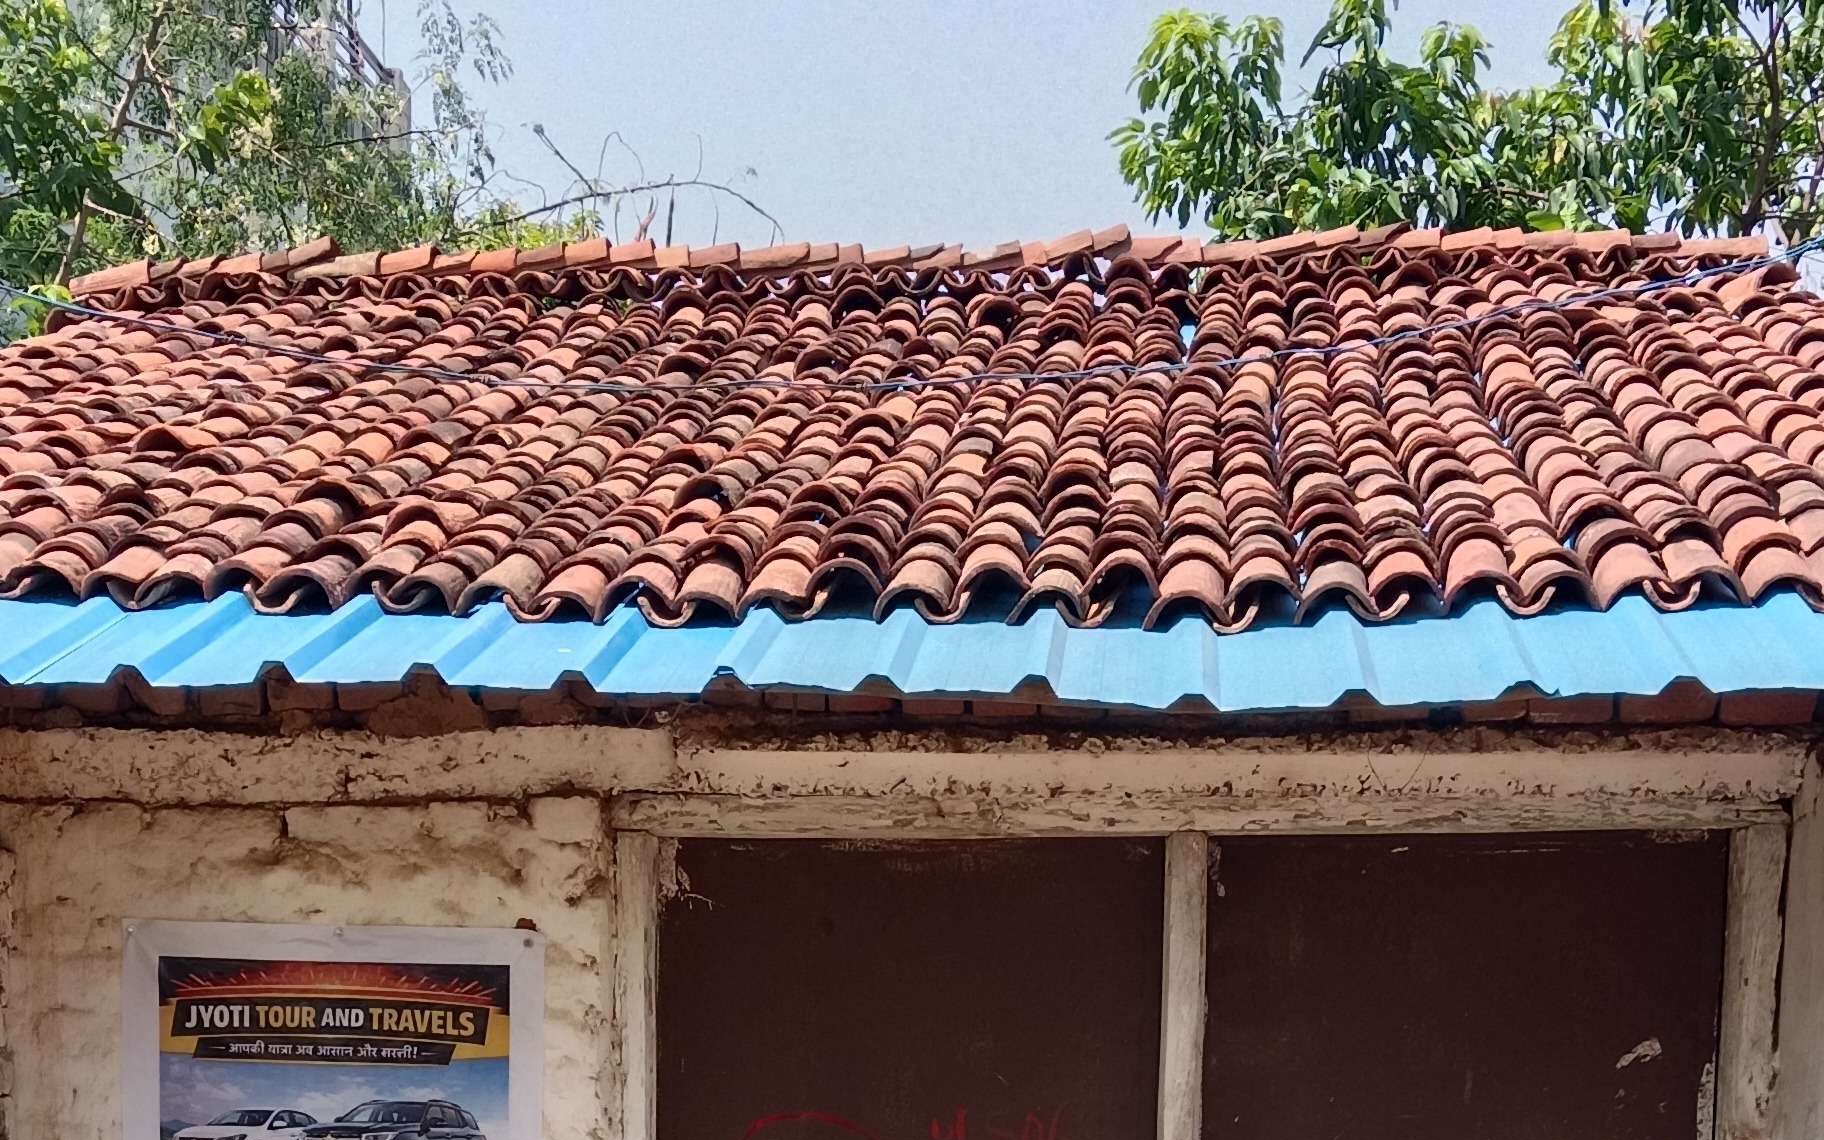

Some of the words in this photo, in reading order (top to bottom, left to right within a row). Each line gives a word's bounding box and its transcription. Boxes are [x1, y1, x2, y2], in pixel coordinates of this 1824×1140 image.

[185, 1005, 249, 1028] JYOTI
[256, 1005, 316, 1028] TOUR
[321, 1007, 364, 1027] AND
[369, 1008, 475, 1036] TRAVELS
[228, 1040, 265, 1054] आपकी
[268, 1044, 293, 1055] यात्रा
[317, 1045, 353, 1057] आसान
[357, 1043, 378, 1057] और
